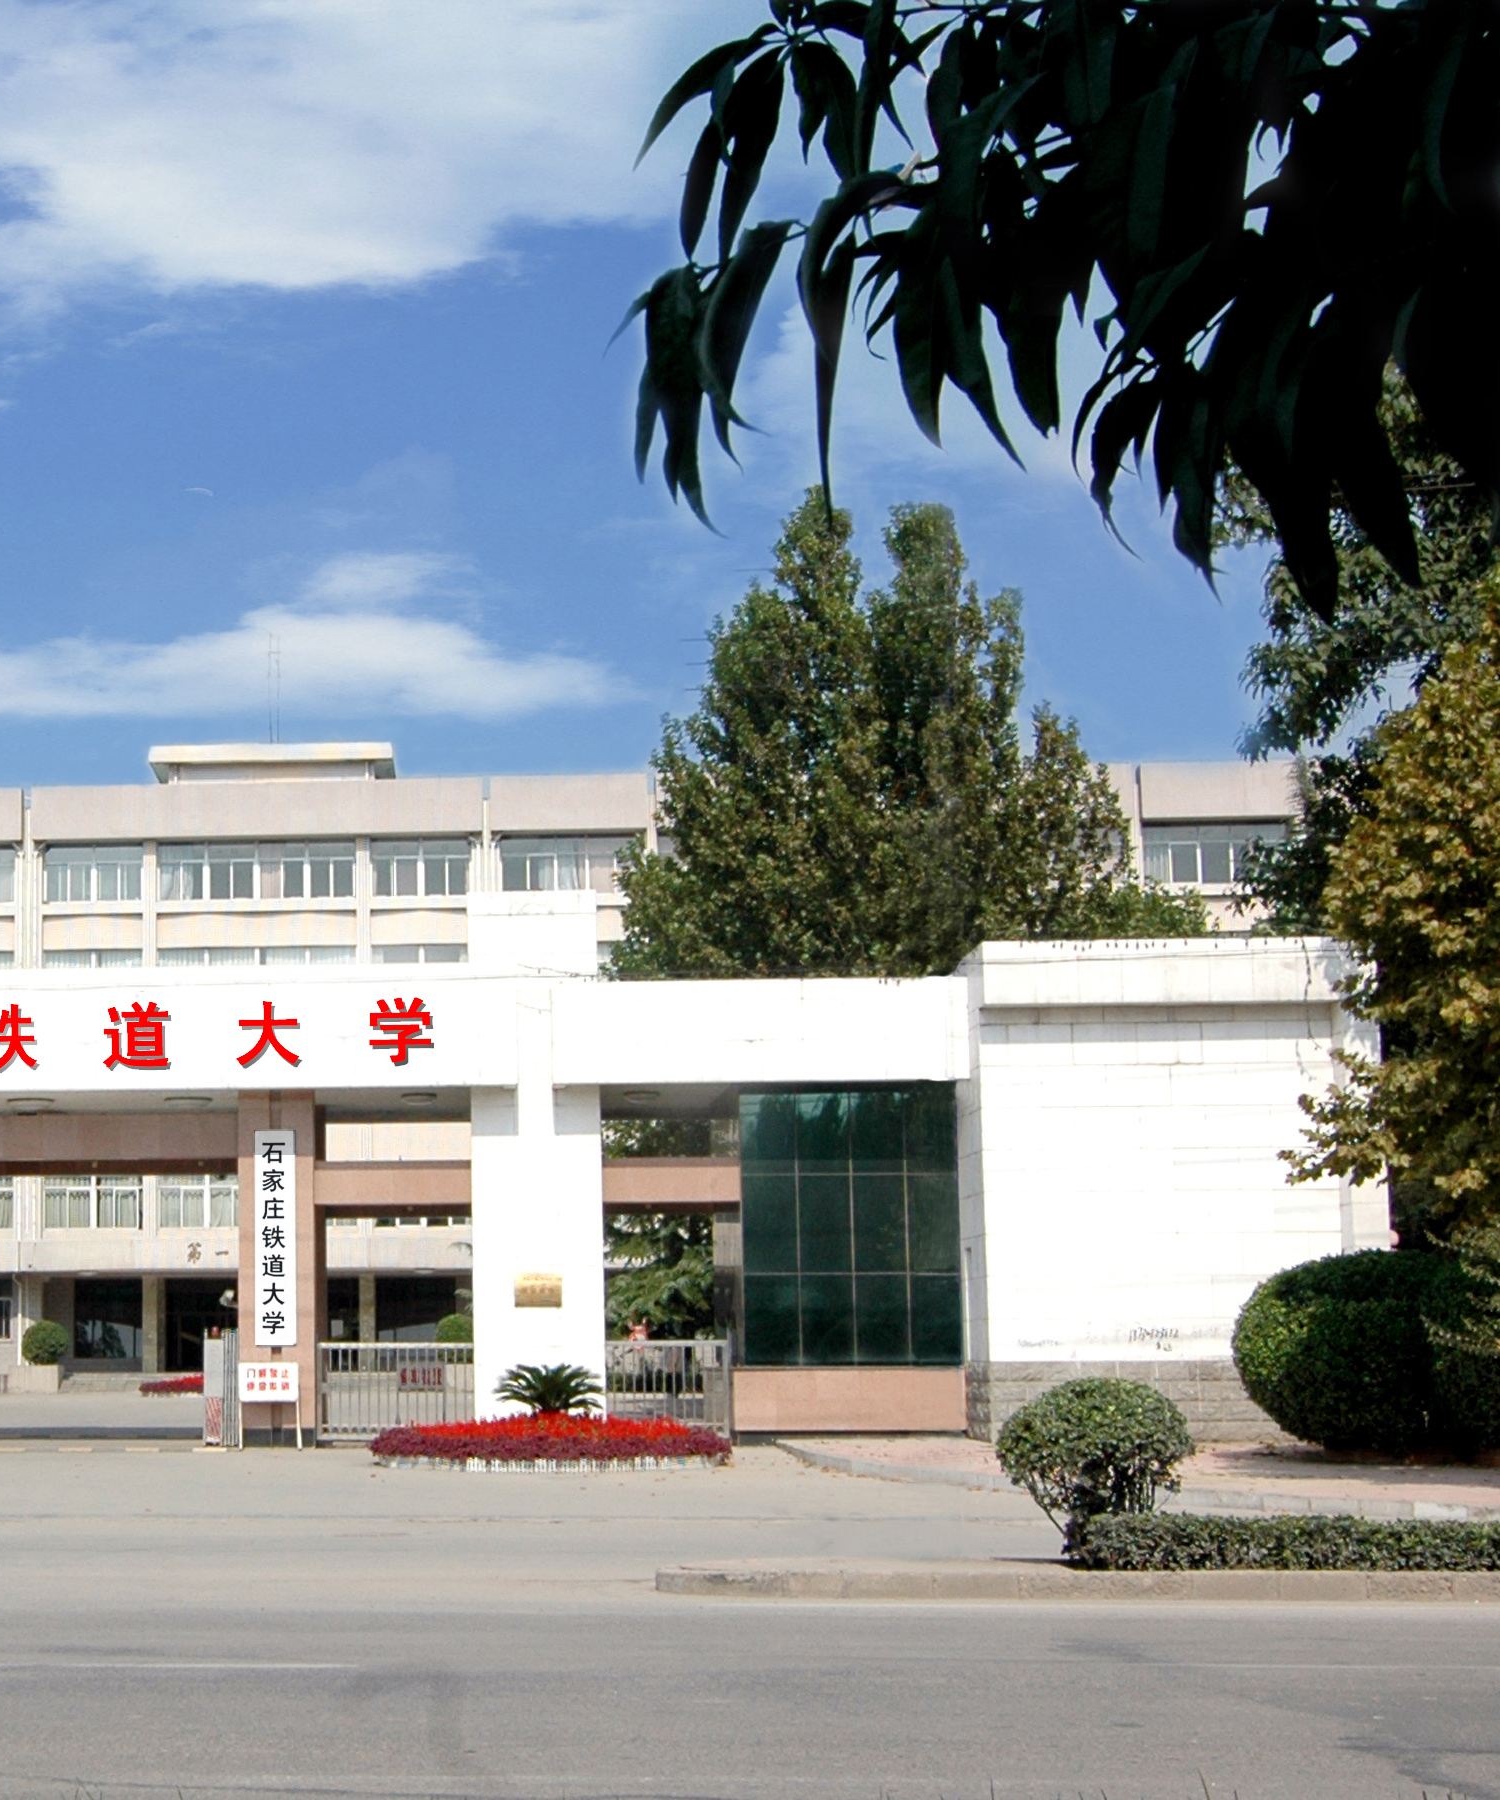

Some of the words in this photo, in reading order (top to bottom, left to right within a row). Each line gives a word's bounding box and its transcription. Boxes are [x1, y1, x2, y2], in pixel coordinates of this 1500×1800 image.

[261, 1142, 286, 1335] 石家庄铁道大学
